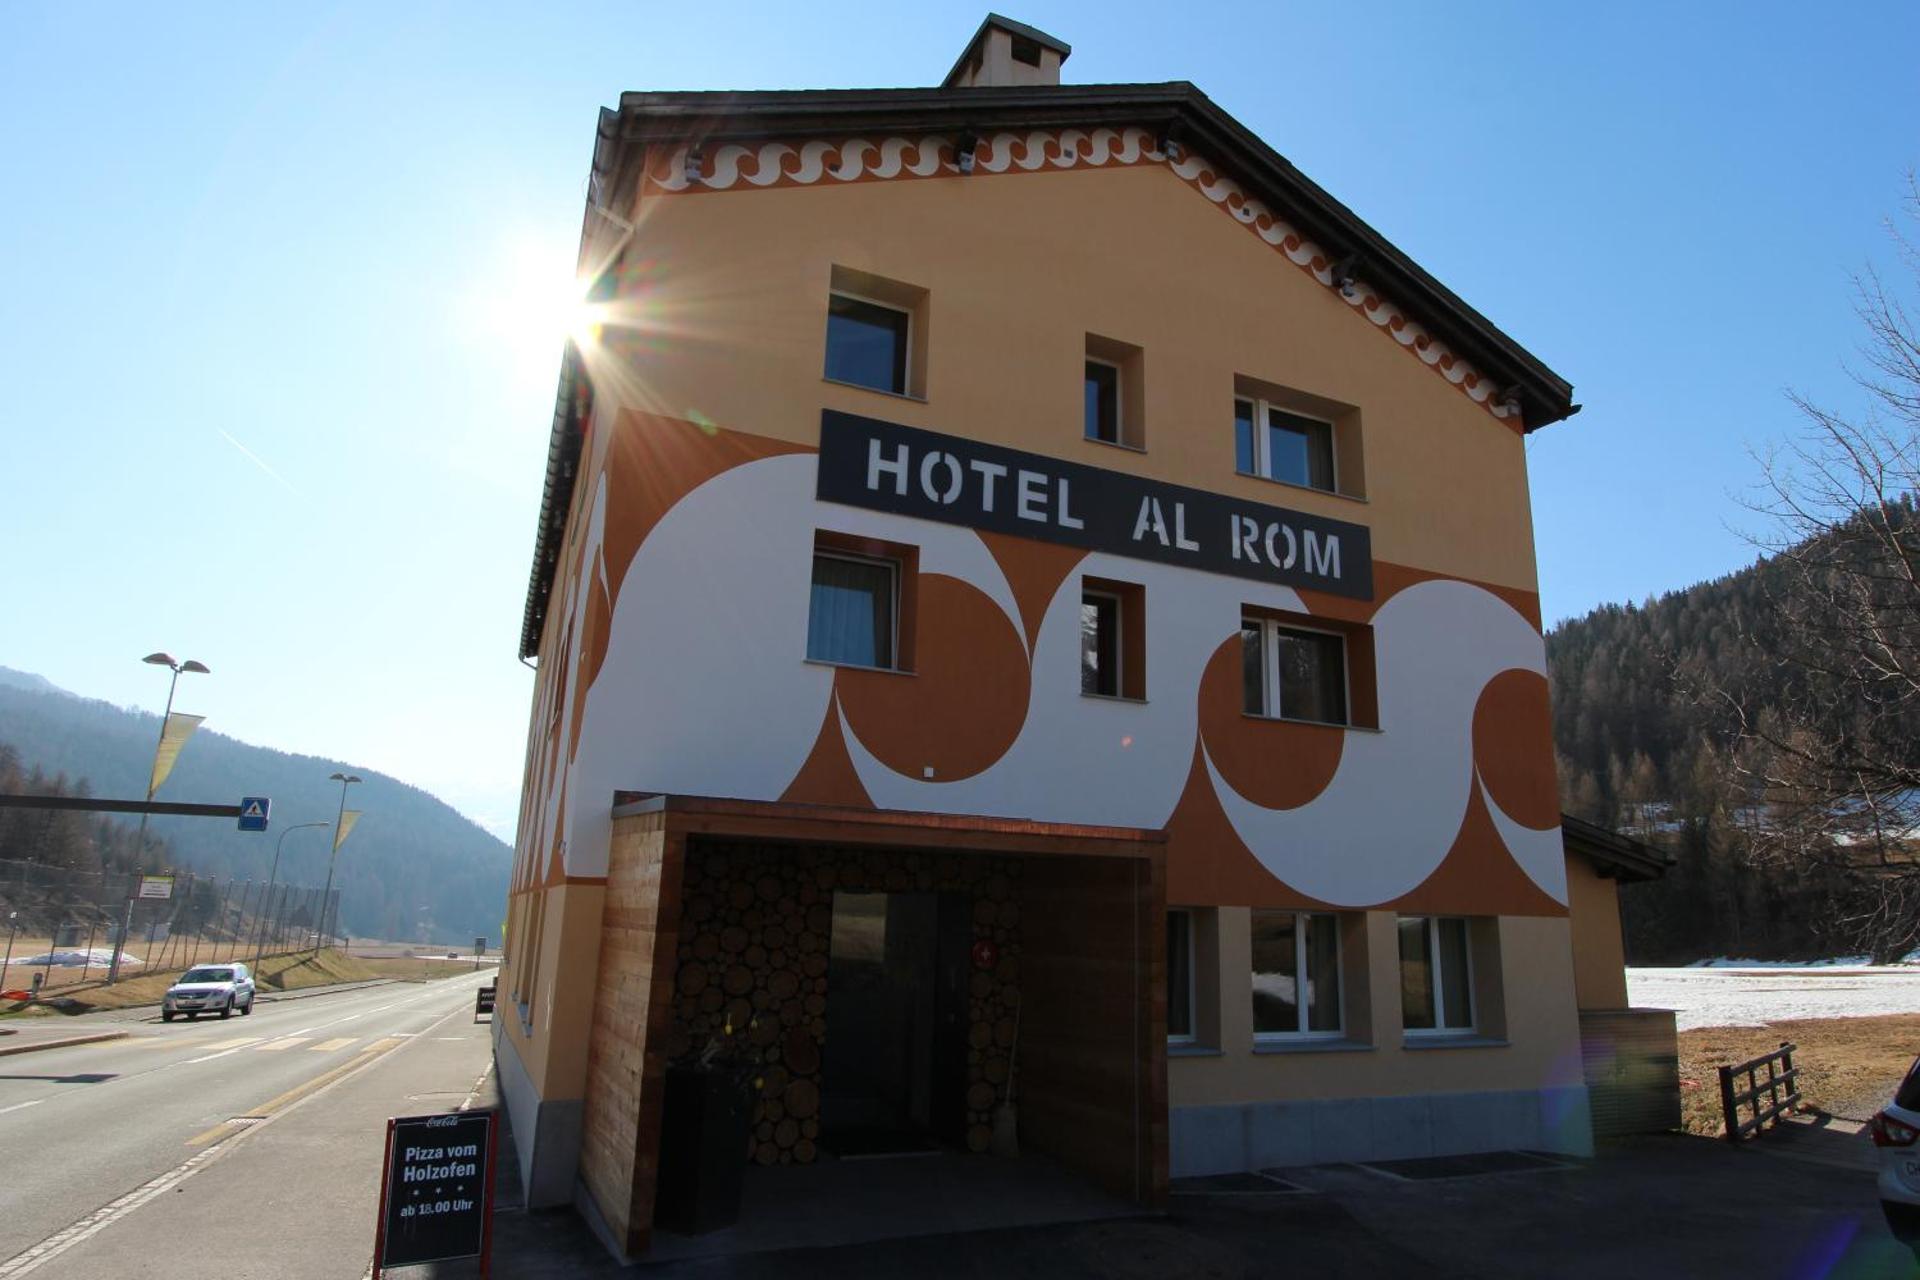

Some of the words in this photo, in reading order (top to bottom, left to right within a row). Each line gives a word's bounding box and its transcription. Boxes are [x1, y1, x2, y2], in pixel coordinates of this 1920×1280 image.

[867, 438, 1084, 529] HOTEL
[1132, 495, 1199, 551] AL
[1231, 514, 1341, 579] ROM
[405, 1147, 443, 1162] Pizza
[447, 1145, 477, 1157] vom
[403, 1162, 476, 1182] Holzofen
[400, 1205, 415, 1217] ab
[418, 1201, 450, 1215] 18.00
[453, 1199, 474, 1211] Uhr
